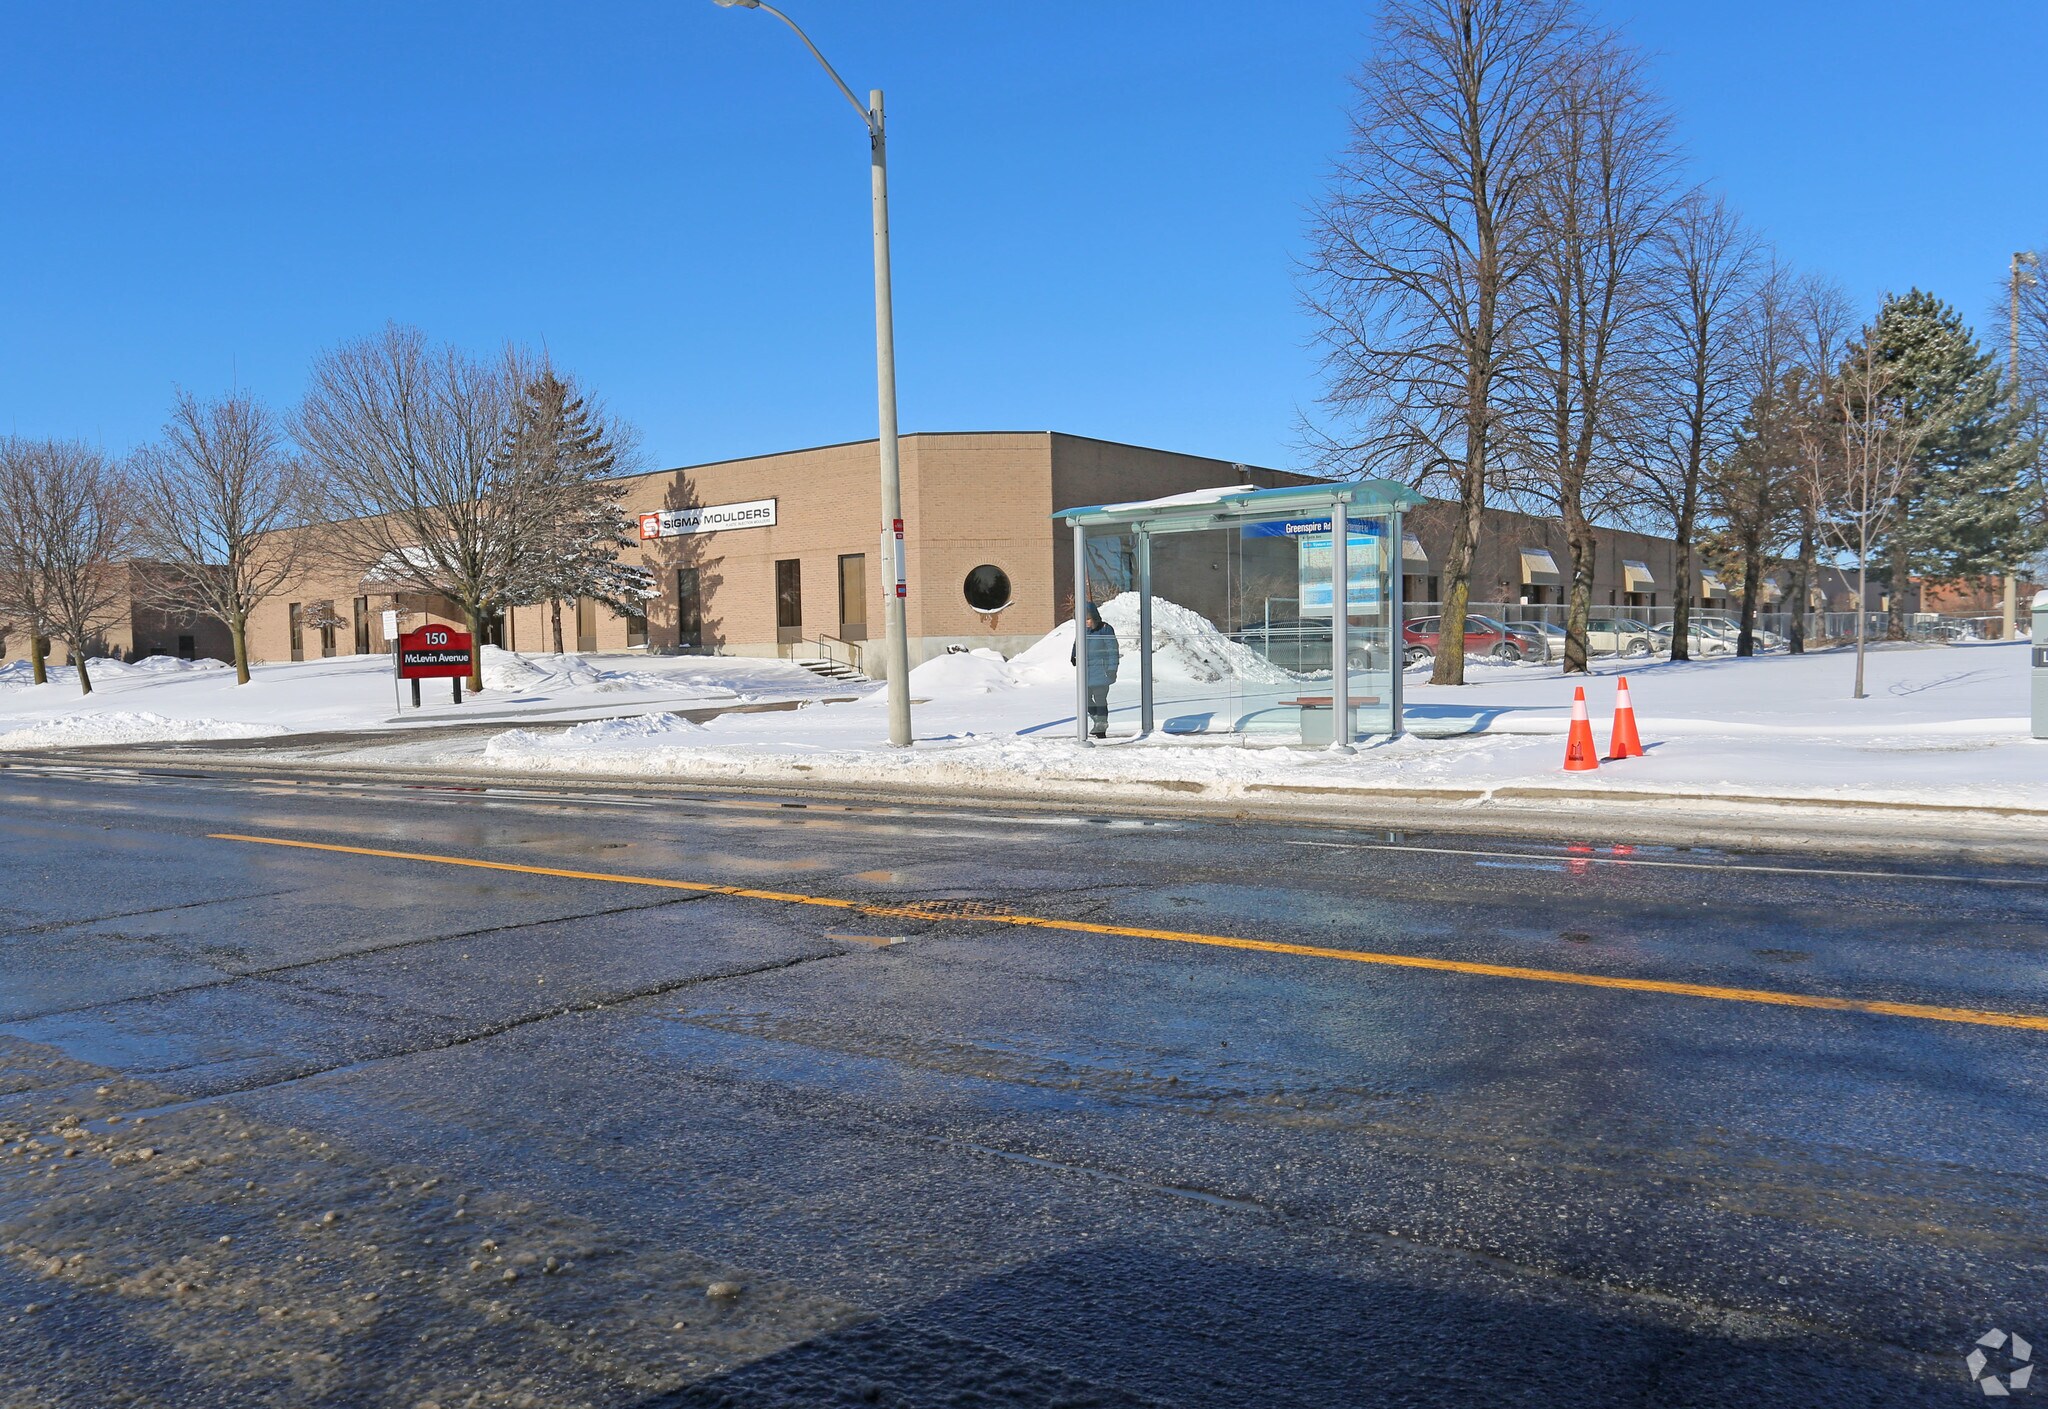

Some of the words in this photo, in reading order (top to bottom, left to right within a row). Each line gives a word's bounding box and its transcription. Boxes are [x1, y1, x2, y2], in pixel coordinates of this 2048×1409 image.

[664, 517, 700, 529] SIGMA
[704, 508, 770, 524] MOULDERS
[1286, 522, 1322, 533] Greenspire
[1323, 522, 1331, 530] Rd
[425, 632, 447, 645] 150
[405, 654, 437, 663] McLevin
[439, 653, 468, 662] Avenue
